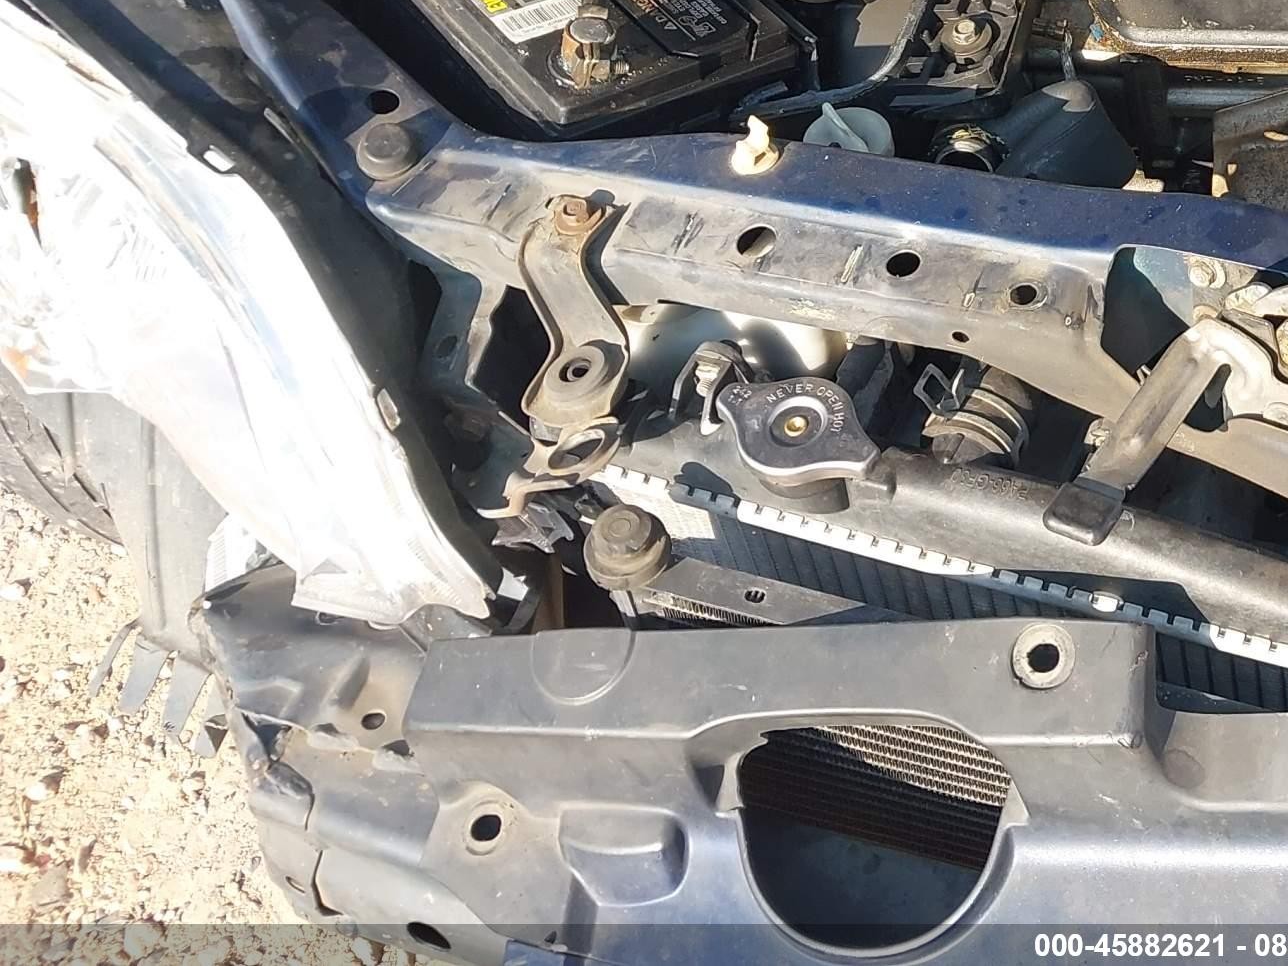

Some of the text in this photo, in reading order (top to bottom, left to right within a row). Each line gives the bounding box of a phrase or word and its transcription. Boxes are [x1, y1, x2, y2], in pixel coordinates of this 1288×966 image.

[766, 383, 844, 433] NEVER OPEN HOT
